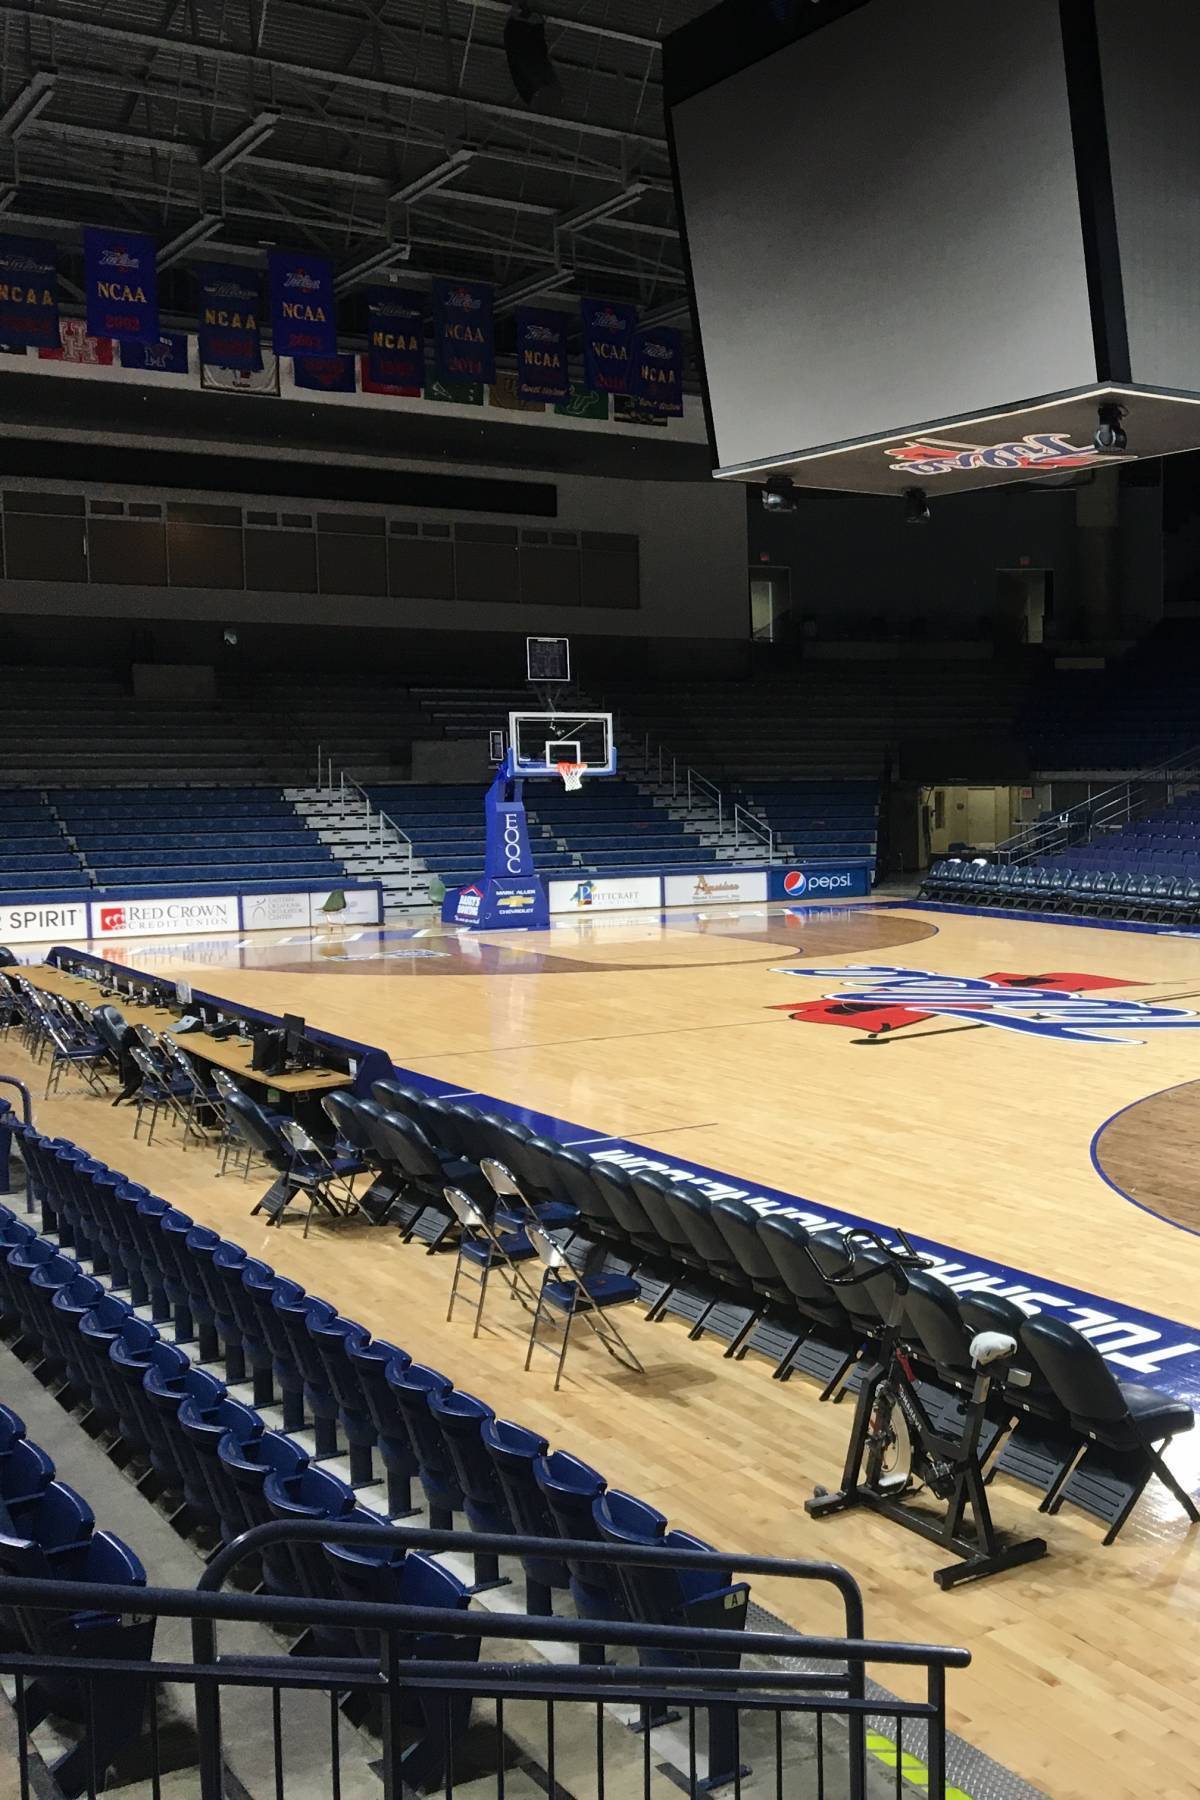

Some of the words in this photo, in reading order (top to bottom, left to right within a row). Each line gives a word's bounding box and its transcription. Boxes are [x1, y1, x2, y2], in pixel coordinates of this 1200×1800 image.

[97, 281, 148, 304] NCAA
[205, 308, 257, 330] NCAA
[282, 301, 326, 322] NCAA
[373, 330, 418, 352] NCAA
[445, 323, 484, 342] NCAA
[524, 350, 560, 368] NCAA
[592, 342, 628, 361] NCAA
[641, 363, 676, 384] NCAA
[504, 813, 521, 874] EOOC
[808, 873, 852, 892] pepsi
[10, 910, 77, 929] SPIRIT
[130, 906, 162, 921] RED
[167, 903, 228, 920] CROWN
[130, 920, 178, 930] CREDIT
[187, 917, 228, 928] UNION
[731, 1593, 738, 1607] A
